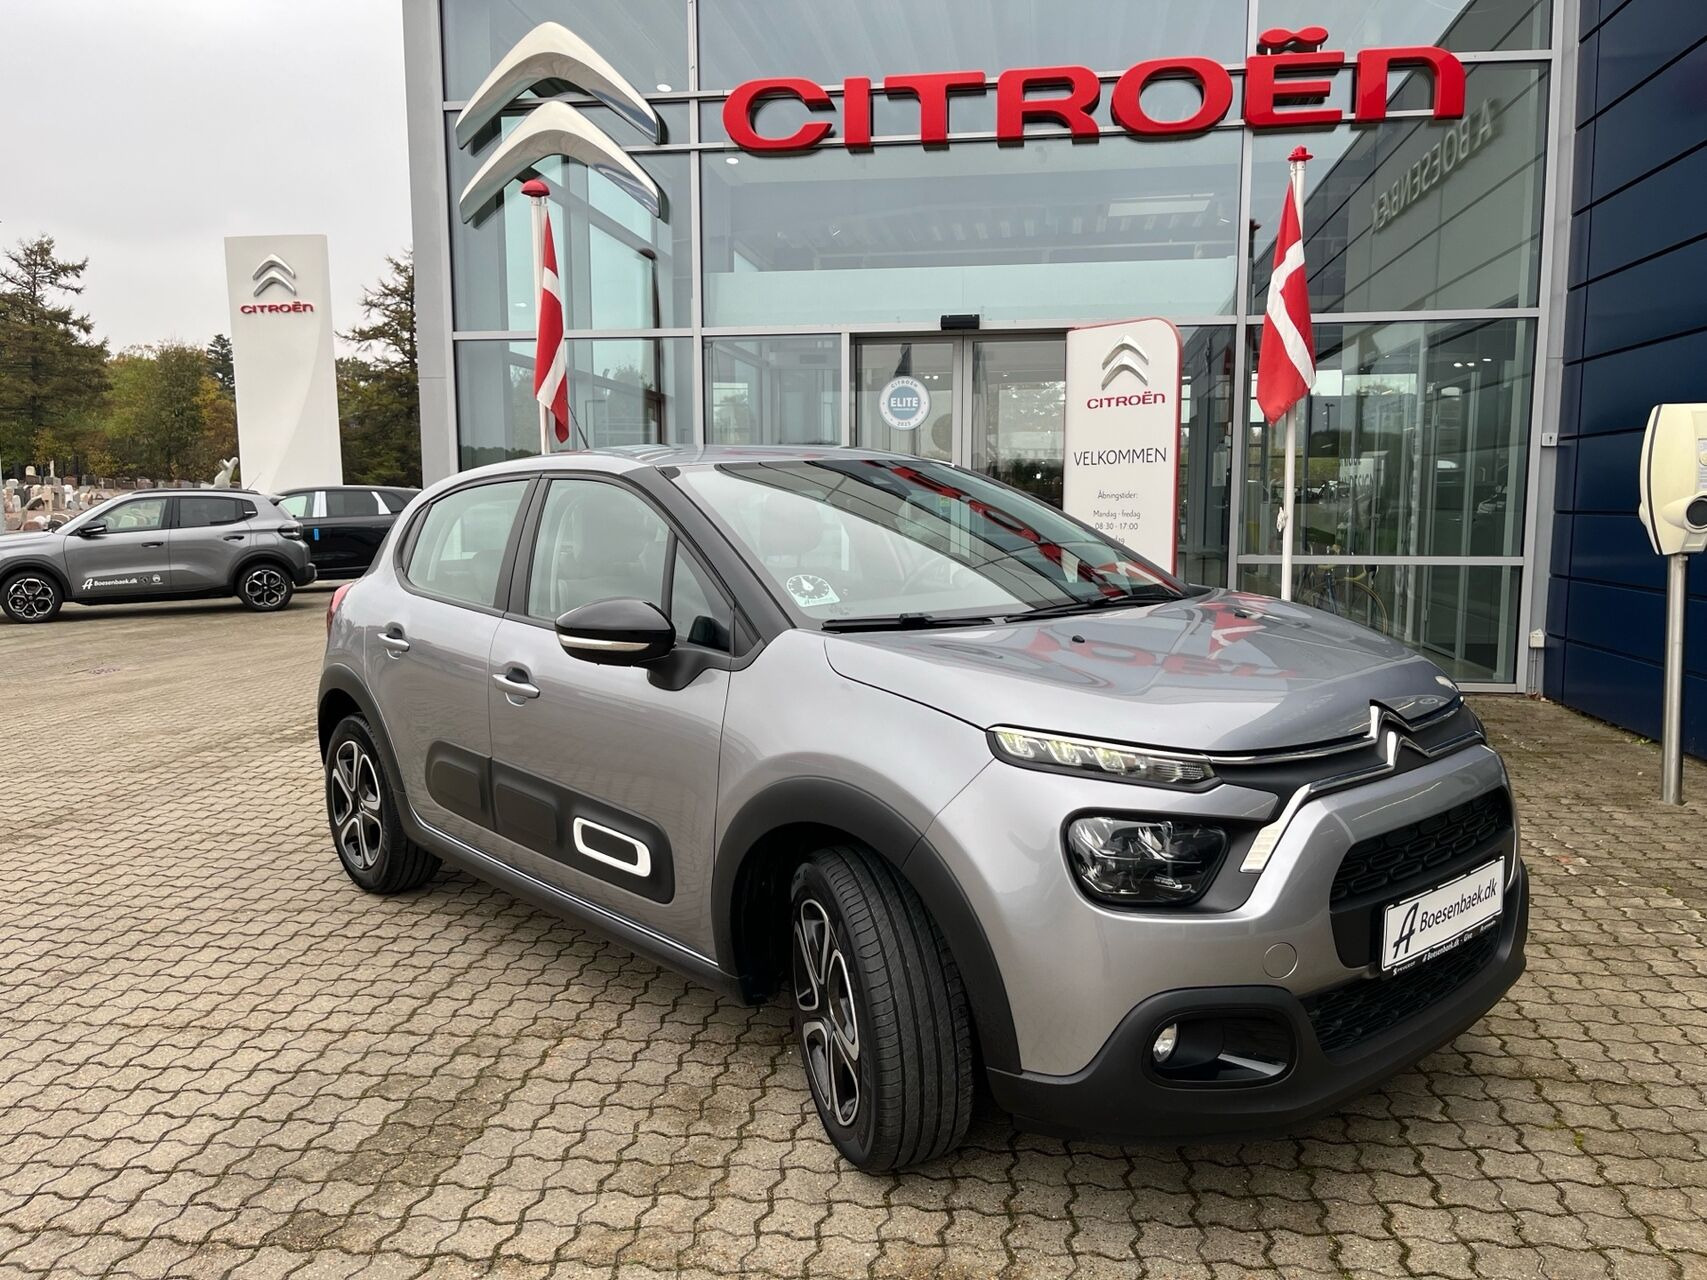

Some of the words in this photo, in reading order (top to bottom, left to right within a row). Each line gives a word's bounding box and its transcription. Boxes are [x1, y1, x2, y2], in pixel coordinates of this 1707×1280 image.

[890, 397, 919, 407] ELITE
[1073, 447, 1167, 466] VELKOMMEN
[1420, 877, 1498, 933] Boesenbaek.dk
